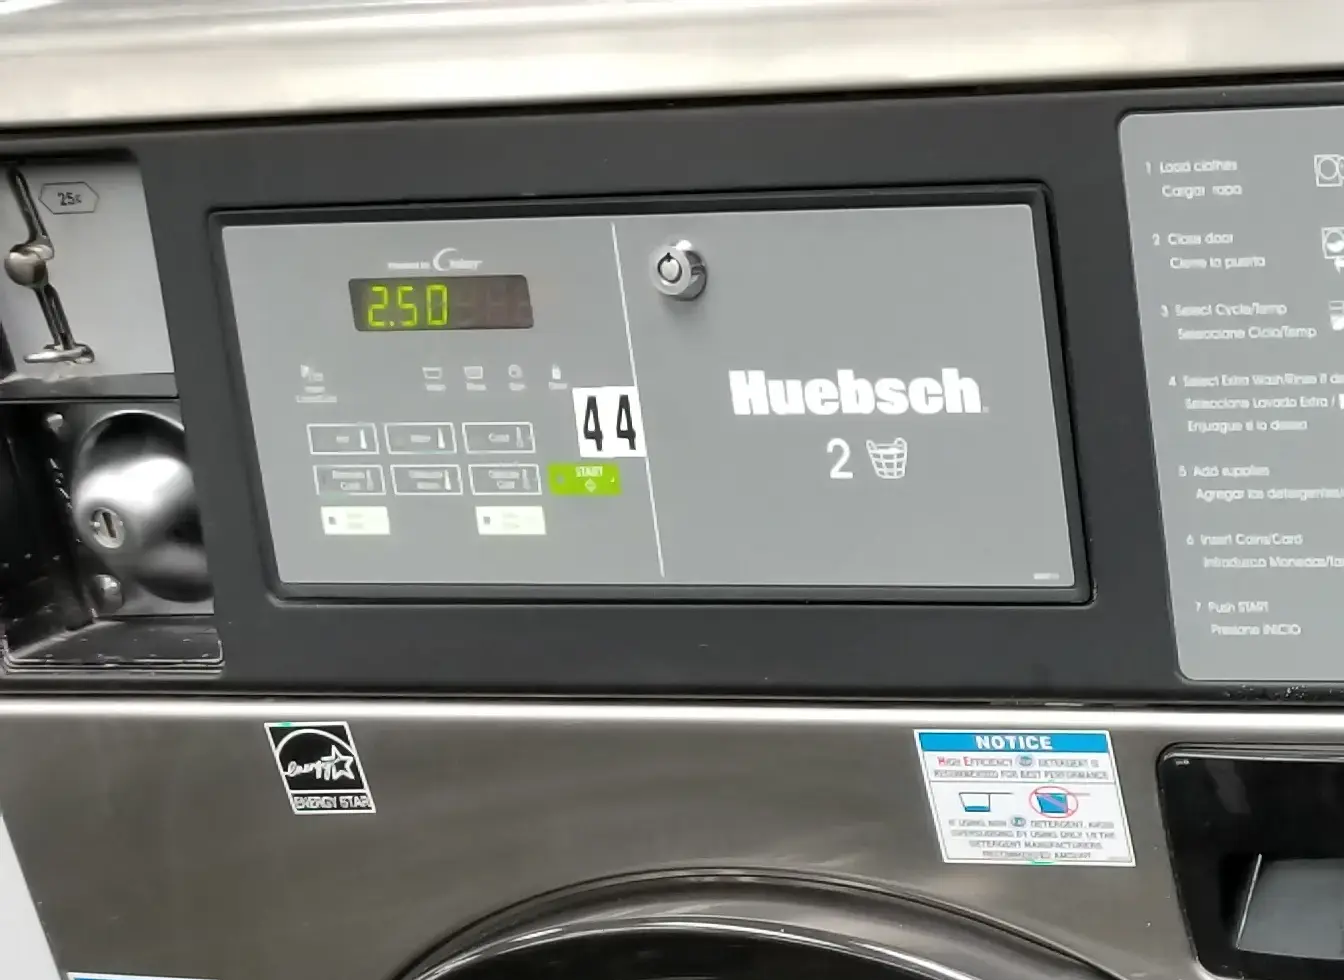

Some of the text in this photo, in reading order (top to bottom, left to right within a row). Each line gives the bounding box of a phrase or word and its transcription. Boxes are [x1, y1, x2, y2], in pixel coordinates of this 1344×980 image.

[368, 284, 448, 327] 2.50
[729, 367, 982, 416] Huebsch
[583, 394, 637, 452] 44
[826, 437, 853, 480] 2
[975, 735, 1053, 750] NOTICE
